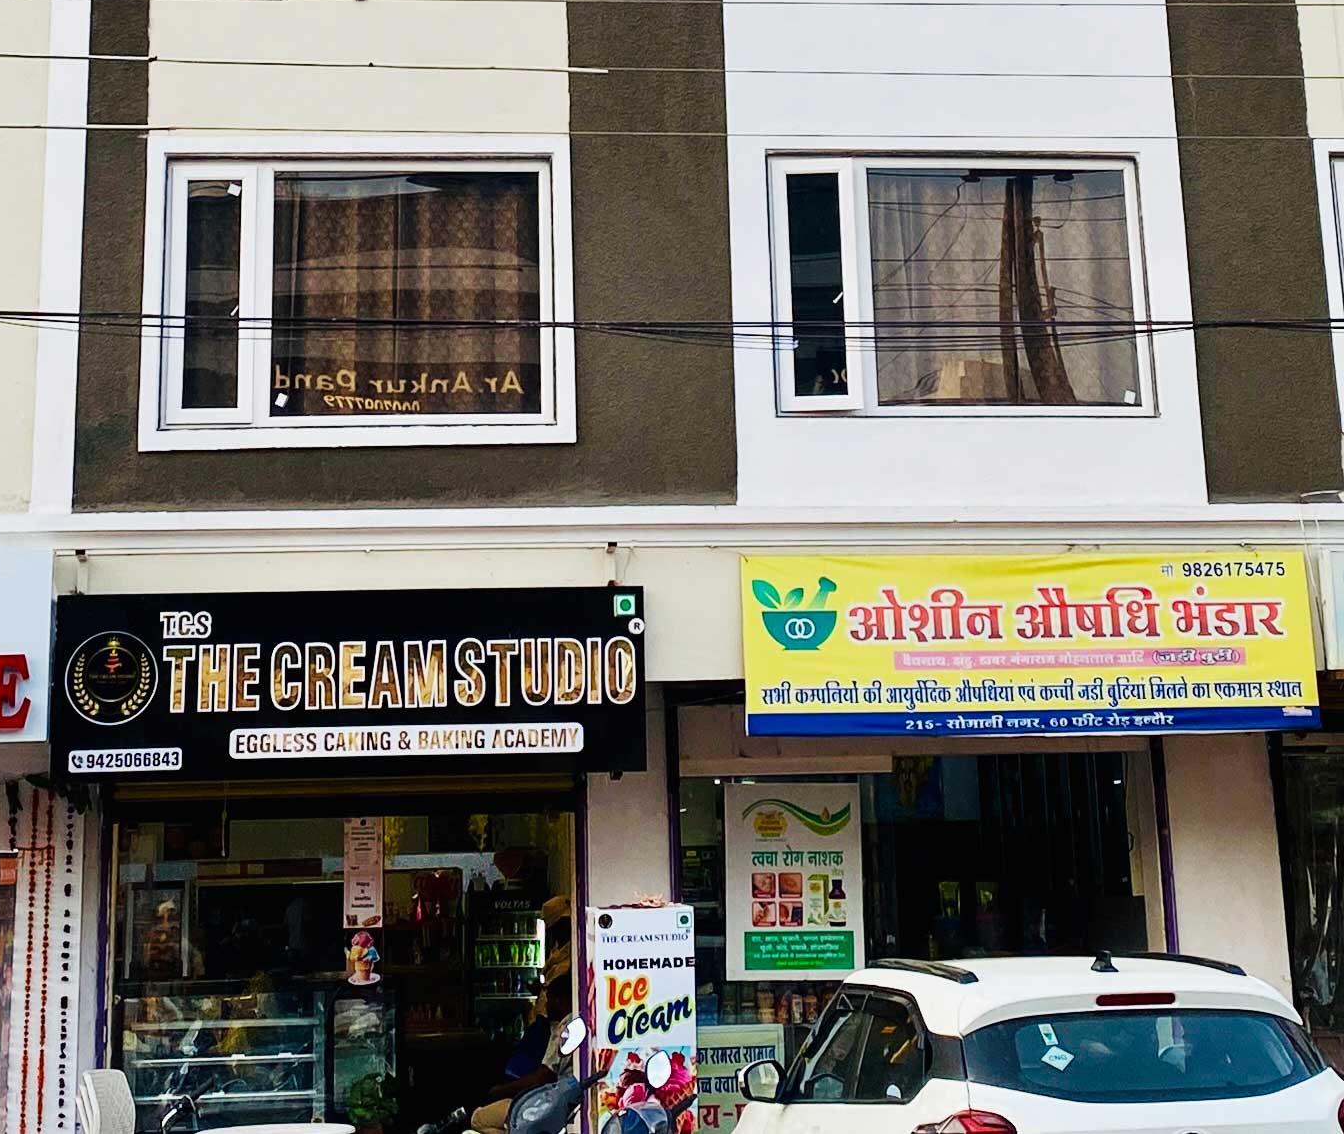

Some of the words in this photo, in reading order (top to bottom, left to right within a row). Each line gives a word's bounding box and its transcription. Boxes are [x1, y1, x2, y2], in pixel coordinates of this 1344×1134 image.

[1182, 561, 1285, 577] 9826175475
[849, 588, 1003, 642] ओशीन
[1016, 586, 1161, 639] औषधि
[1171, 585, 1284, 637] भंडार
[163, 643, 261, 713] THE
[270, 640, 447, 711] CREAM
[454, 636, 636, 707] STUDIO
[761, 681, 791, 704] सभी
[863, 680, 882, 703] की
[1018, 678, 1036, 702] एवं
[1039, 678, 1074, 701] कच्ची
[1149, 676, 1188, 699] मिलने
[1192, 682, 1211, 698] का
[1214, 681, 1264, 700] एकमात्र
[1266, 680, 1303, 698] स्थान
[1050, 717, 1068, 728] 60
[235, 732, 317, 754] EGGLESS
[324, 730, 391, 752] CAKING
[398, 730, 411, 750] &
[418, 729, 485, 750] BAKING
[492, 727, 578, 749] ACADEMY
[86, 751, 180, 769] 9425066843
[751, 850, 779, 867] त्वचा
[782, 845, 804, 867] रोग
[807, 850, 844, 867] नाशक
[621, 933, 653, 943] CREAM
[654, 932, 689, 942] STUDIO
[603, 957, 696, 971] HOMEMADE
[607, 976, 648, 1010] Ice
[608, 996, 693, 1045] Cream
